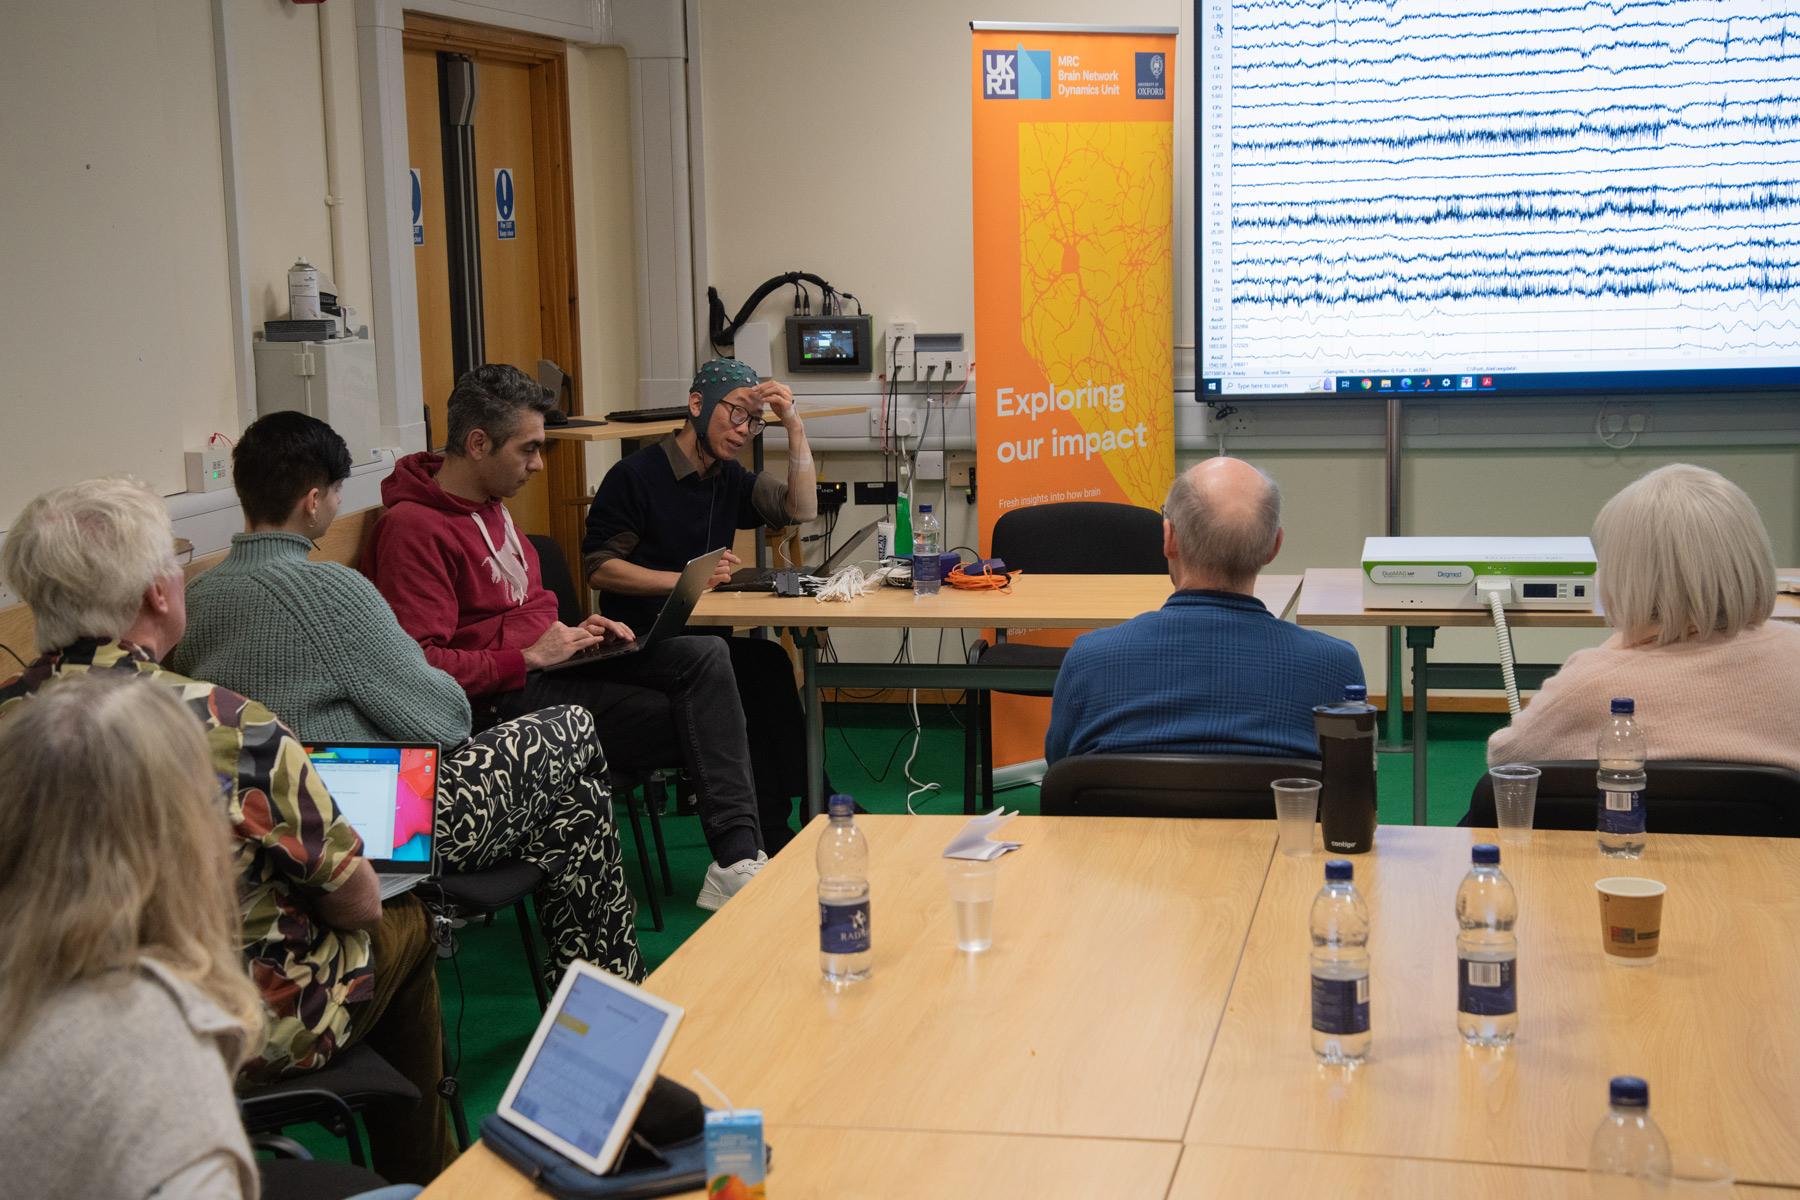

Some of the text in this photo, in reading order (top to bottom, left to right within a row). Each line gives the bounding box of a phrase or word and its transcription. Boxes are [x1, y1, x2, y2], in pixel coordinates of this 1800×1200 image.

[1058, 56, 1080, 66] MRC
[1058, 70, 1119, 81] Brain Network
[1058, 84, 1120, 97] Dynamics Unit
[1137, 87, 1164, 96] OXFORD
[1237, 383, 1250, 391] Type
[996, 380, 1125, 421] Exploring
[997, 422, 1147, 463] our impact
[999, 487, 1101, 508] Fresh insights into how brain
[1331, 841, 1357, 849] contigo
